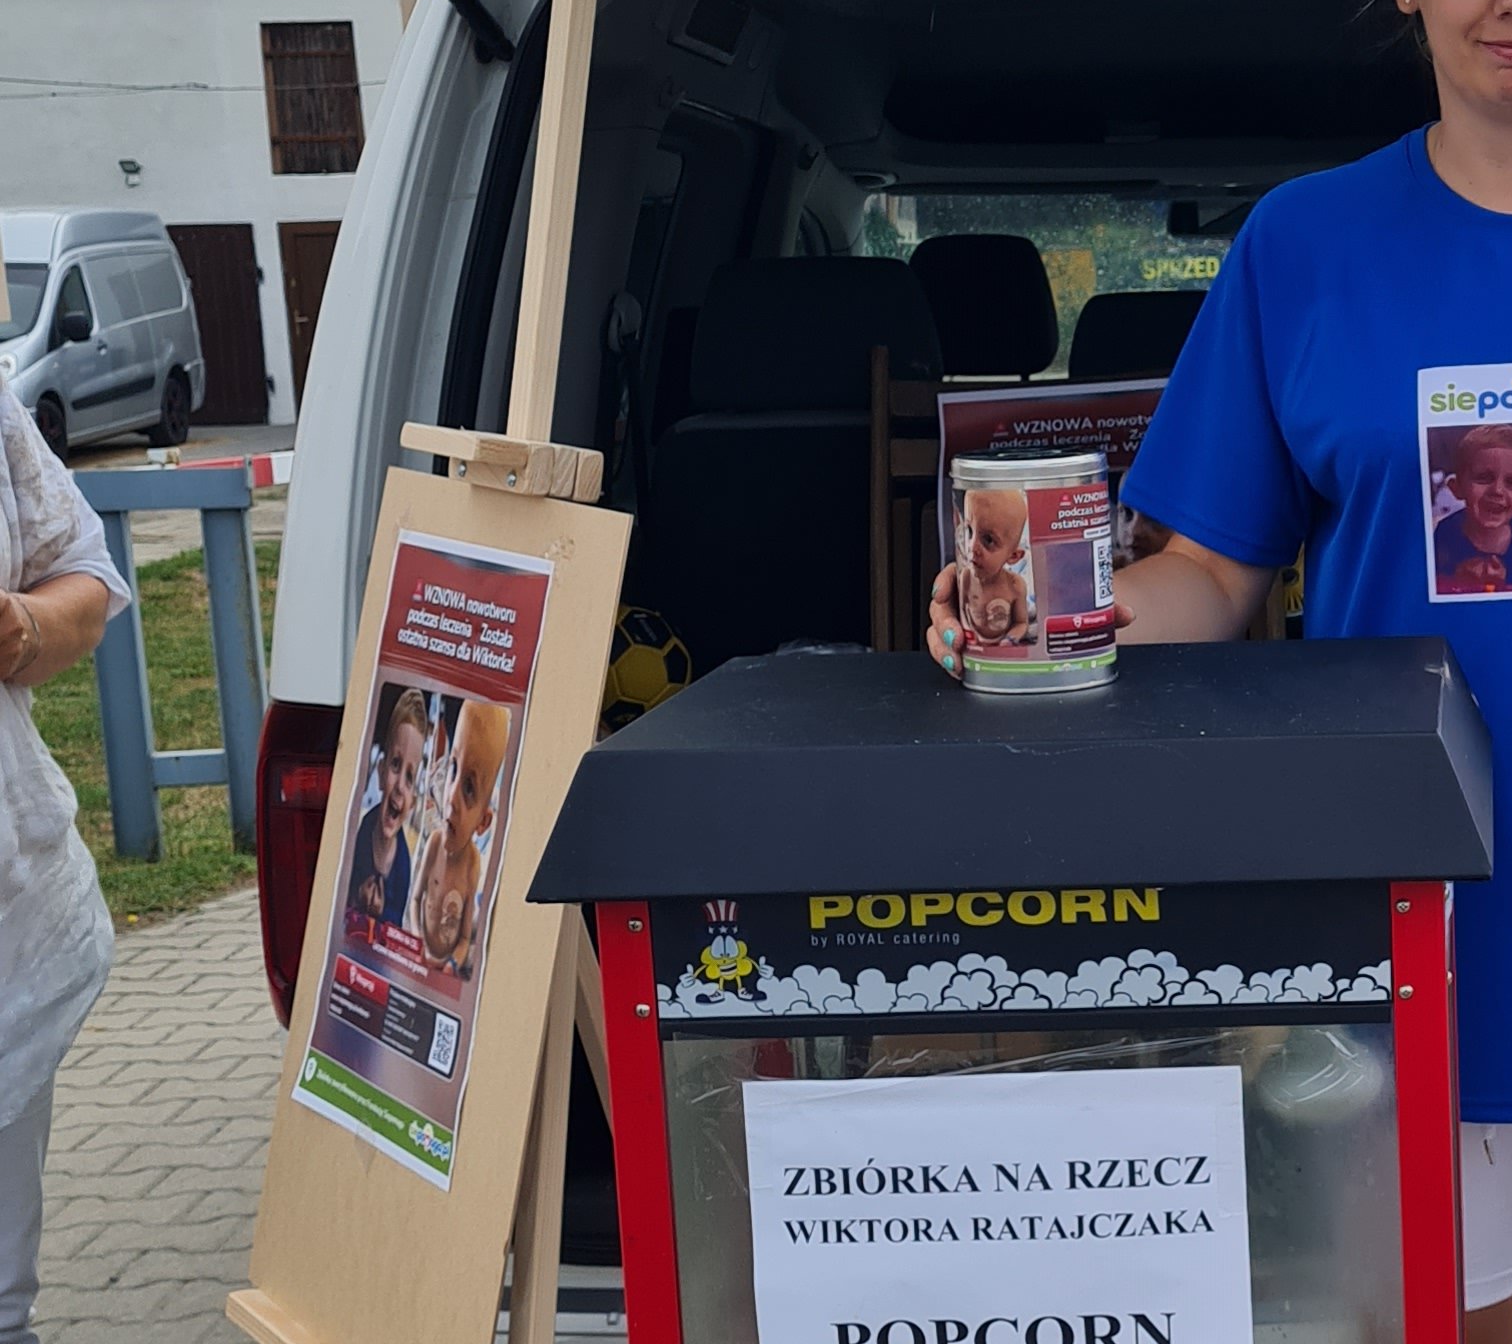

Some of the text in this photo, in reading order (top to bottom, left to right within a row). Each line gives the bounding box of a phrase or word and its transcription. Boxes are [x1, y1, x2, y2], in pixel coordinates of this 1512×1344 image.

[1013, 417, 1093, 434] WZNOWA
[424, 584, 466, 611] WZNOWA
[809, 888, 1161, 929] POPCORN
[811, 931, 960, 948] by ROYAL catering
[783, 1156, 1212, 1197] ZBIÓRKA NA RZECZ
[783, 1209, 1215, 1245] WIKTORA RATAJCZAKA
